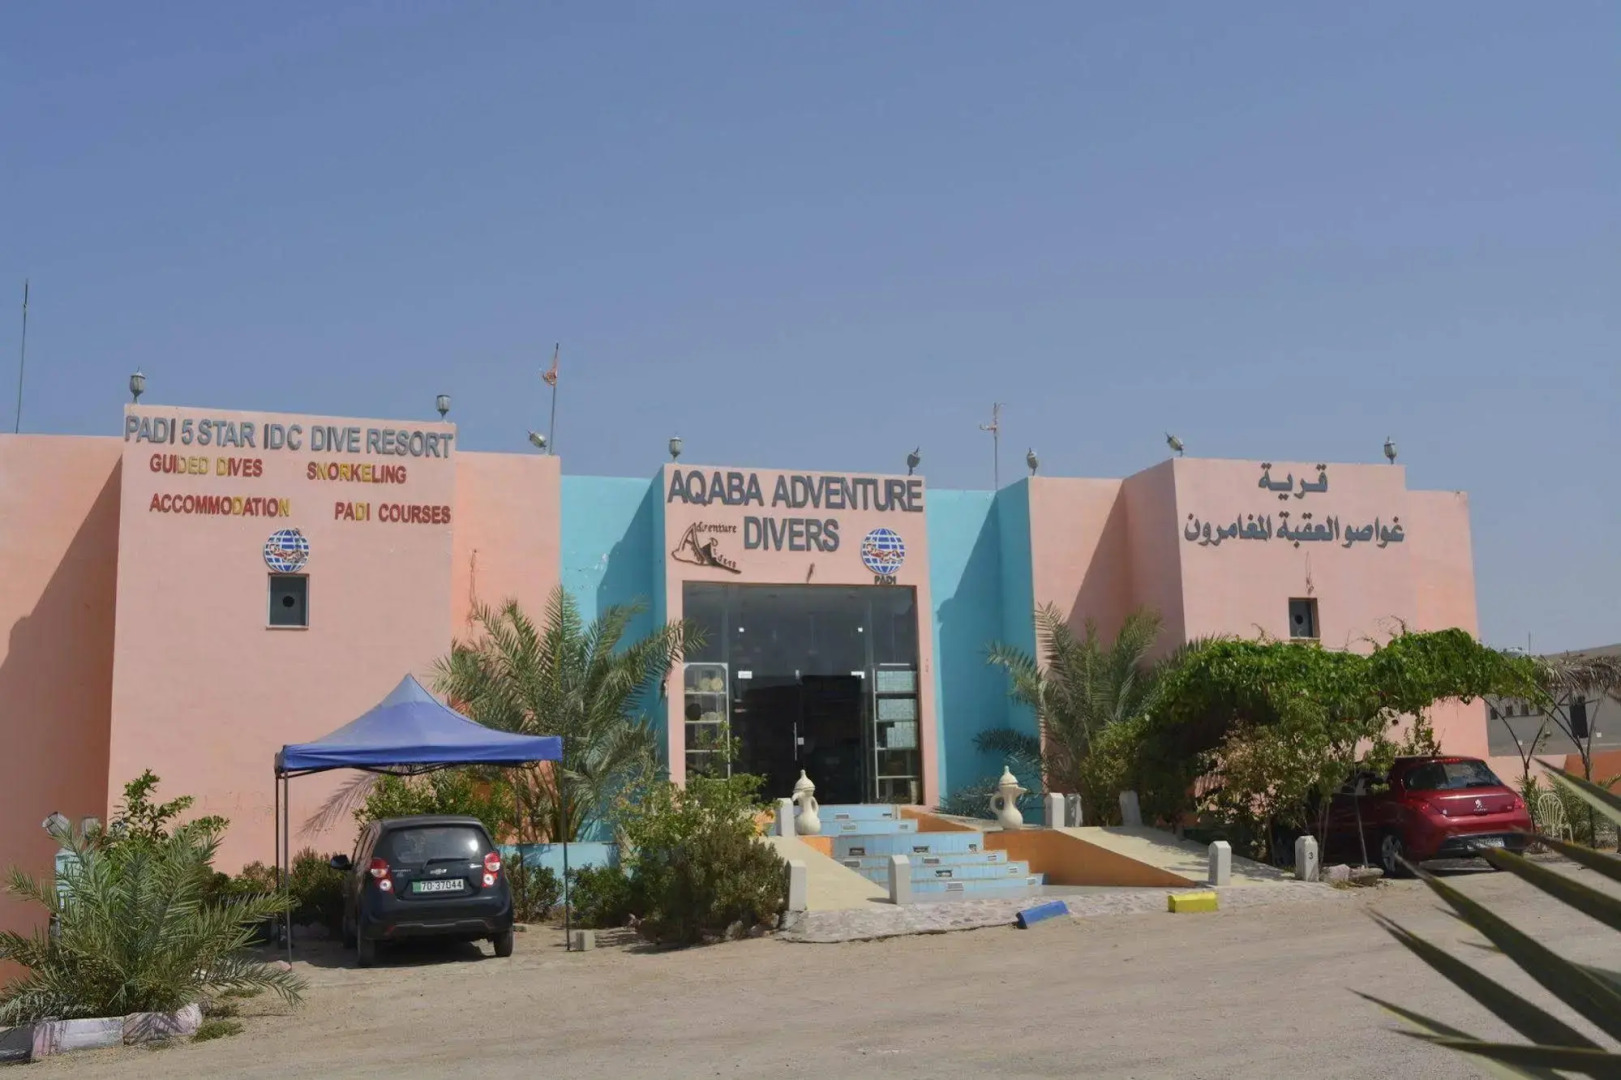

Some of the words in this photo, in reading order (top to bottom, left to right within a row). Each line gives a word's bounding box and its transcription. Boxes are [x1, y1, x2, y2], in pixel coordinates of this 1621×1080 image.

[125, 415, 176, 444] PADI
[181, 420, 194, 442] 5
[197, 419, 256, 448] STAR
[264, 423, 302, 450] IDC
[311, 425, 361, 453] DIVE
[366, 428, 454, 459] RESORT
[150, 453, 208, 475] GUIDED
[216, 456, 263, 478] DIVES
[306, 461, 407, 485] SNORKELING
[1258, 462, 1329, 501] قرية
[149, 493, 290, 518] ACCOMMODATION
[667, 469, 764, 507] AQABA
[771, 474, 924, 513] ADVENTURE
[335, 501, 370, 522] PADI
[378, 504, 451, 524] COURSES
[743, 515, 840, 553] DIVERS
[1184, 513, 1273, 547] المغامرون
[1276, 511, 1340, 549] العقبة
[1341, 515, 1405, 549] غواصو
[874, 575, 897, 586] PADI
[1308, 851, 1314, 860] 3
